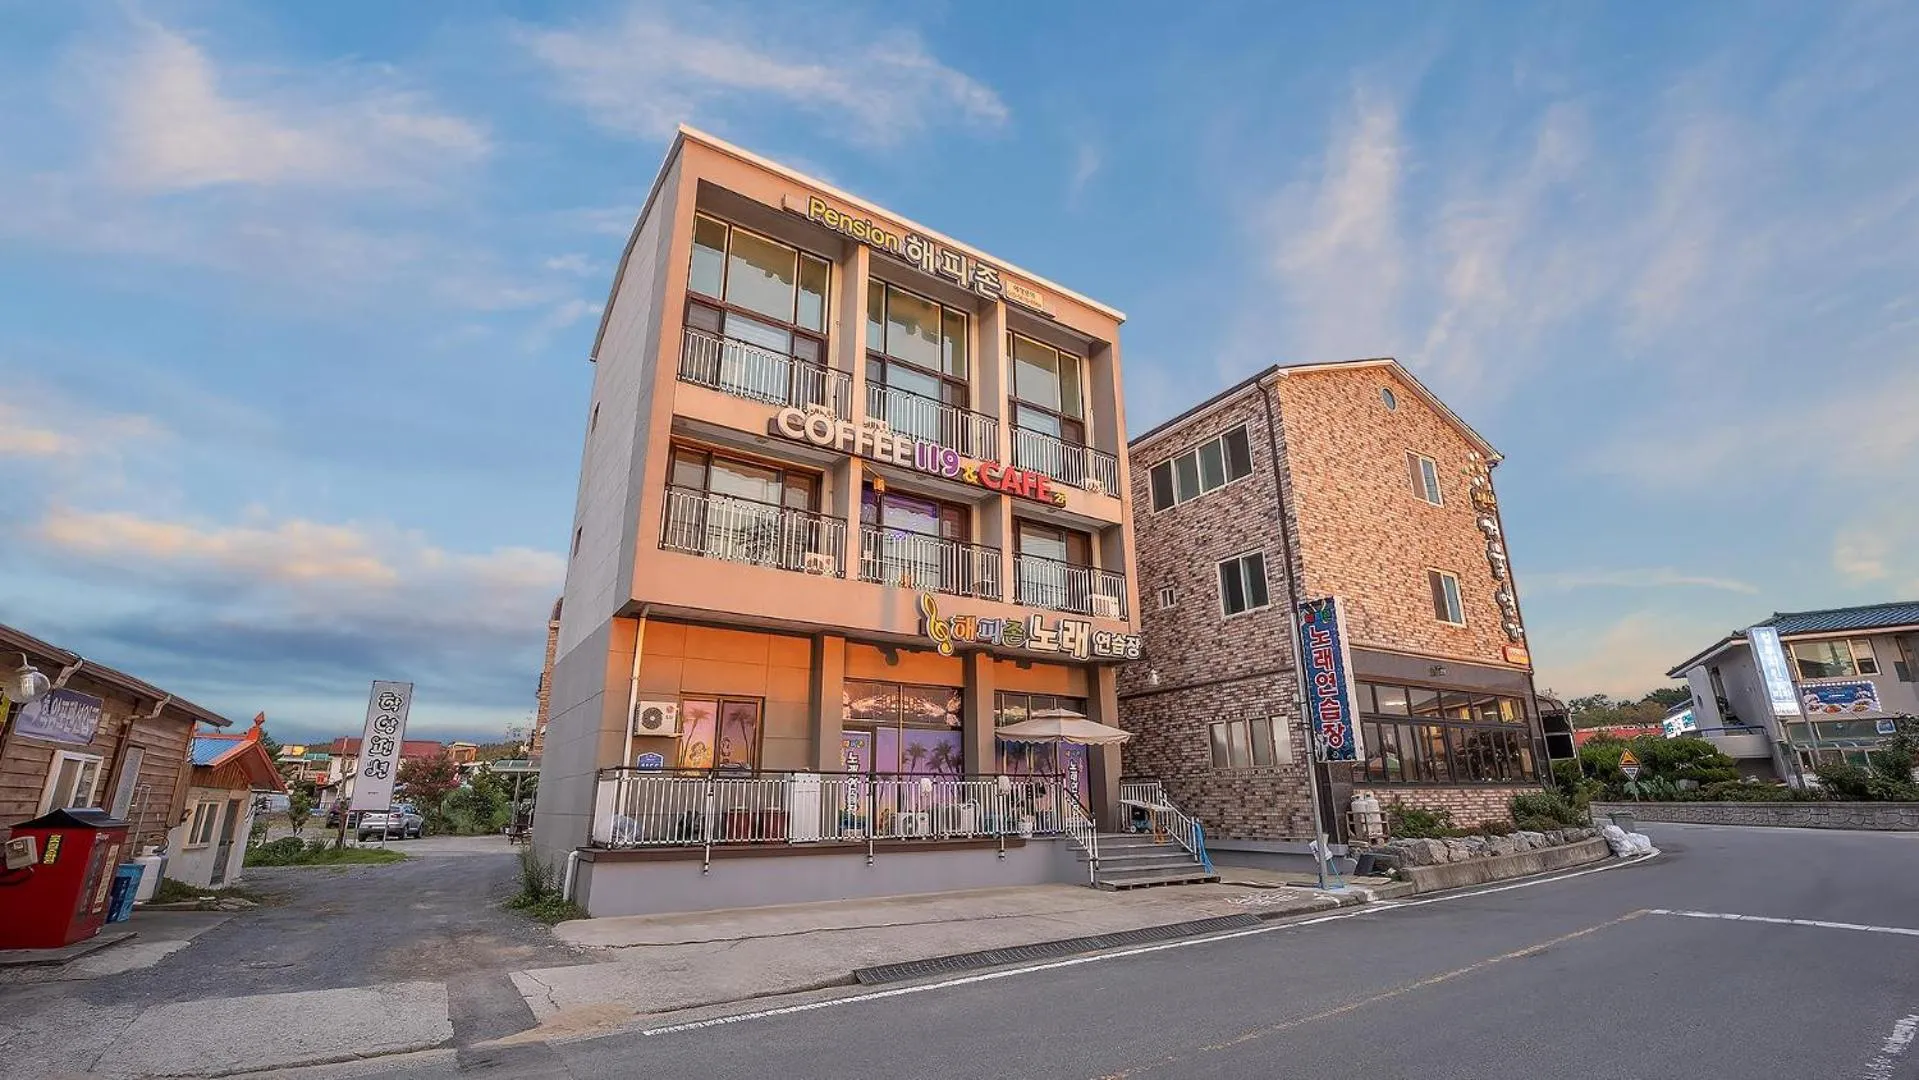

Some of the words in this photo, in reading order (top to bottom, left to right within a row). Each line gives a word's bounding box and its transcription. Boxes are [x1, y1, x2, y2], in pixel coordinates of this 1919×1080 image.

[807, 196, 899, 253] Pension
[904, 232, 1004, 300] 해피존
[777, 407, 912, 466] COFFEE
[913, 441, 961, 477] 119
[962, 464, 979, 484] &
[978, 462, 1052, 501] CAFE
[952, 614, 1027, 648] 해피존
[1026, 613, 1092, 660] 노래
[1092, 630, 1142, 660] 연습장
[1309, 625, 1346, 749] 노래연습장
